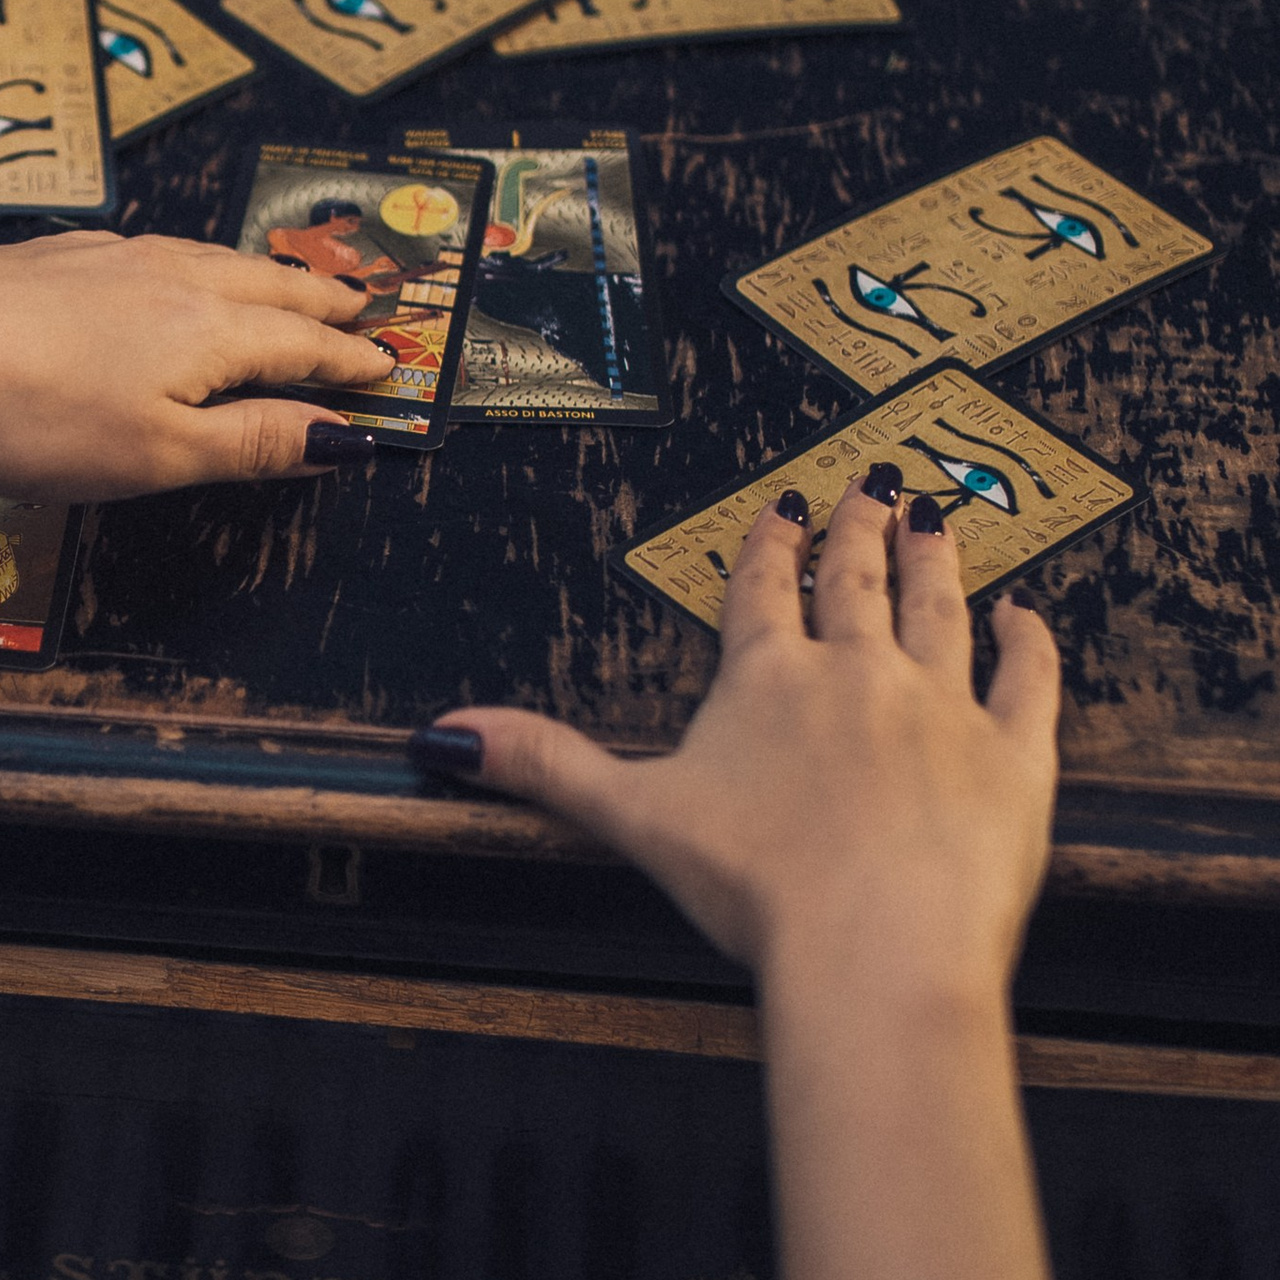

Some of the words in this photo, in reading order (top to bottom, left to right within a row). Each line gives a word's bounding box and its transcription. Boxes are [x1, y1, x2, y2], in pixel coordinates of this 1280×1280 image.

[484, 409, 519, 418] ASSO
[522, 409, 535, 418] DI
[538, 410, 596, 419] BASTONI
